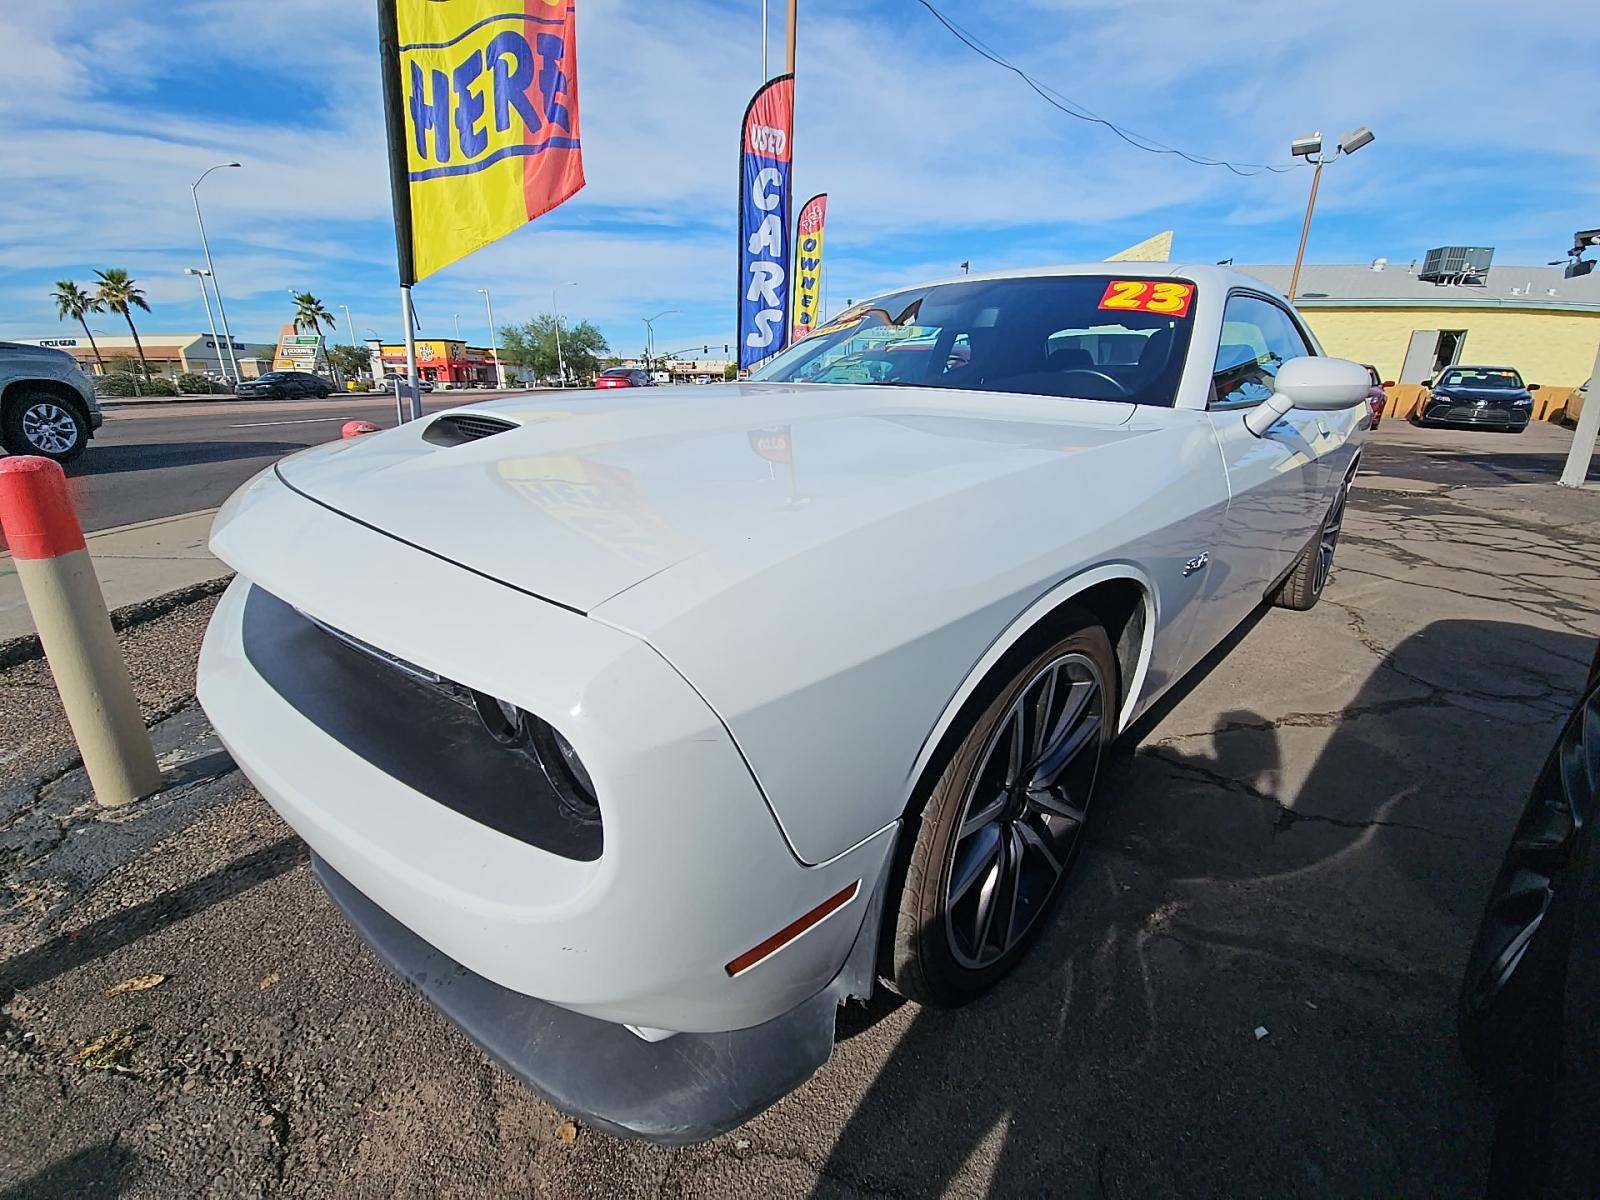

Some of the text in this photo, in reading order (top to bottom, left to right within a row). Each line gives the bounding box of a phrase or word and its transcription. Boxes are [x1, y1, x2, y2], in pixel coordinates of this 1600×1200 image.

[409, 30, 571, 163] HERE
[751, 123, 786, 155] USED
[746, 167, 785, 348] CARS
[800, 237, 819, 325] OWNED
[1103, 281, 1190, 313] 23
[206, 341, 228, 350] CYLE
